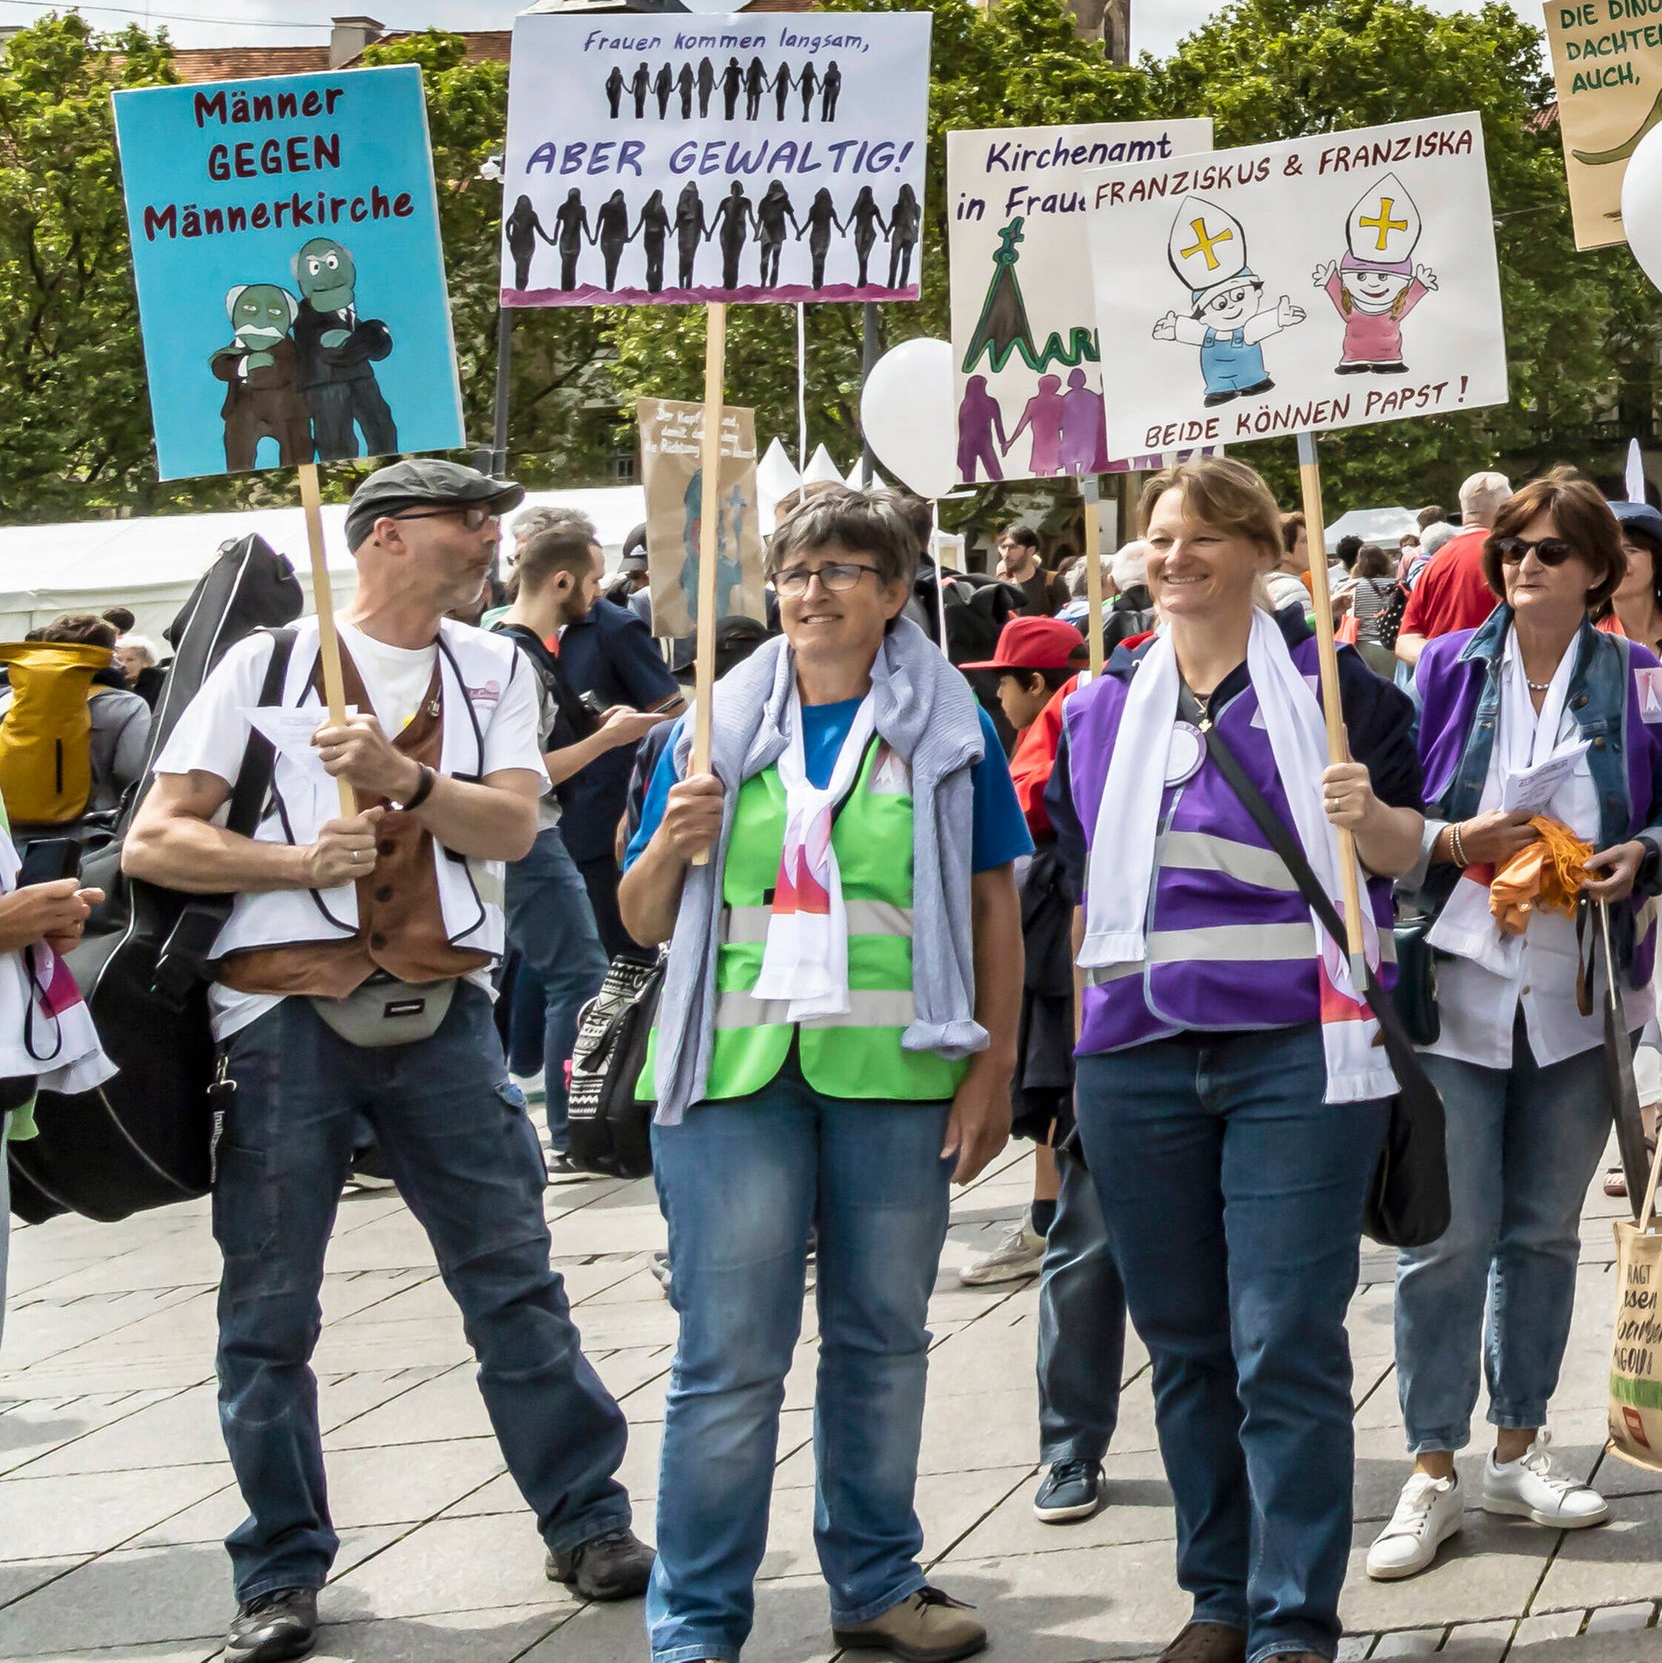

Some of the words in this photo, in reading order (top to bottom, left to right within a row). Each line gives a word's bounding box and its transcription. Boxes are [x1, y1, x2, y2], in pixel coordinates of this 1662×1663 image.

[1560, 3, 1598, 29] DIE
[584, 30, 662, 52] Frauen
[674, 31, 766, 51] kommen
[779, 27, 870, 54] langsam,
[1571, 62, 1640, 94] AUCH,
[194, 84, 345, 129] Männer
[207, 134, 341, 182] GEGEN
[526, 140, 646, 176] ABER
[669, 139, 914, 176] GEWALTIG!
[986, 132, 1172, 173] Kirchenamt
[1096, 156, 1270, 209] FRANZISKUS
[1284, 152, 1303, 176] &
[1318, 128, 1474, 175] FRANZISKA
[144, 185, 416, 242] Männerkirche
[957, 192, 985, 221] in
[1145, 409, 1220, 448] BEIDE
[1237, 392, 1351, 437] KÖNNEN
[1365, 381, 1448, 417] PAPST
